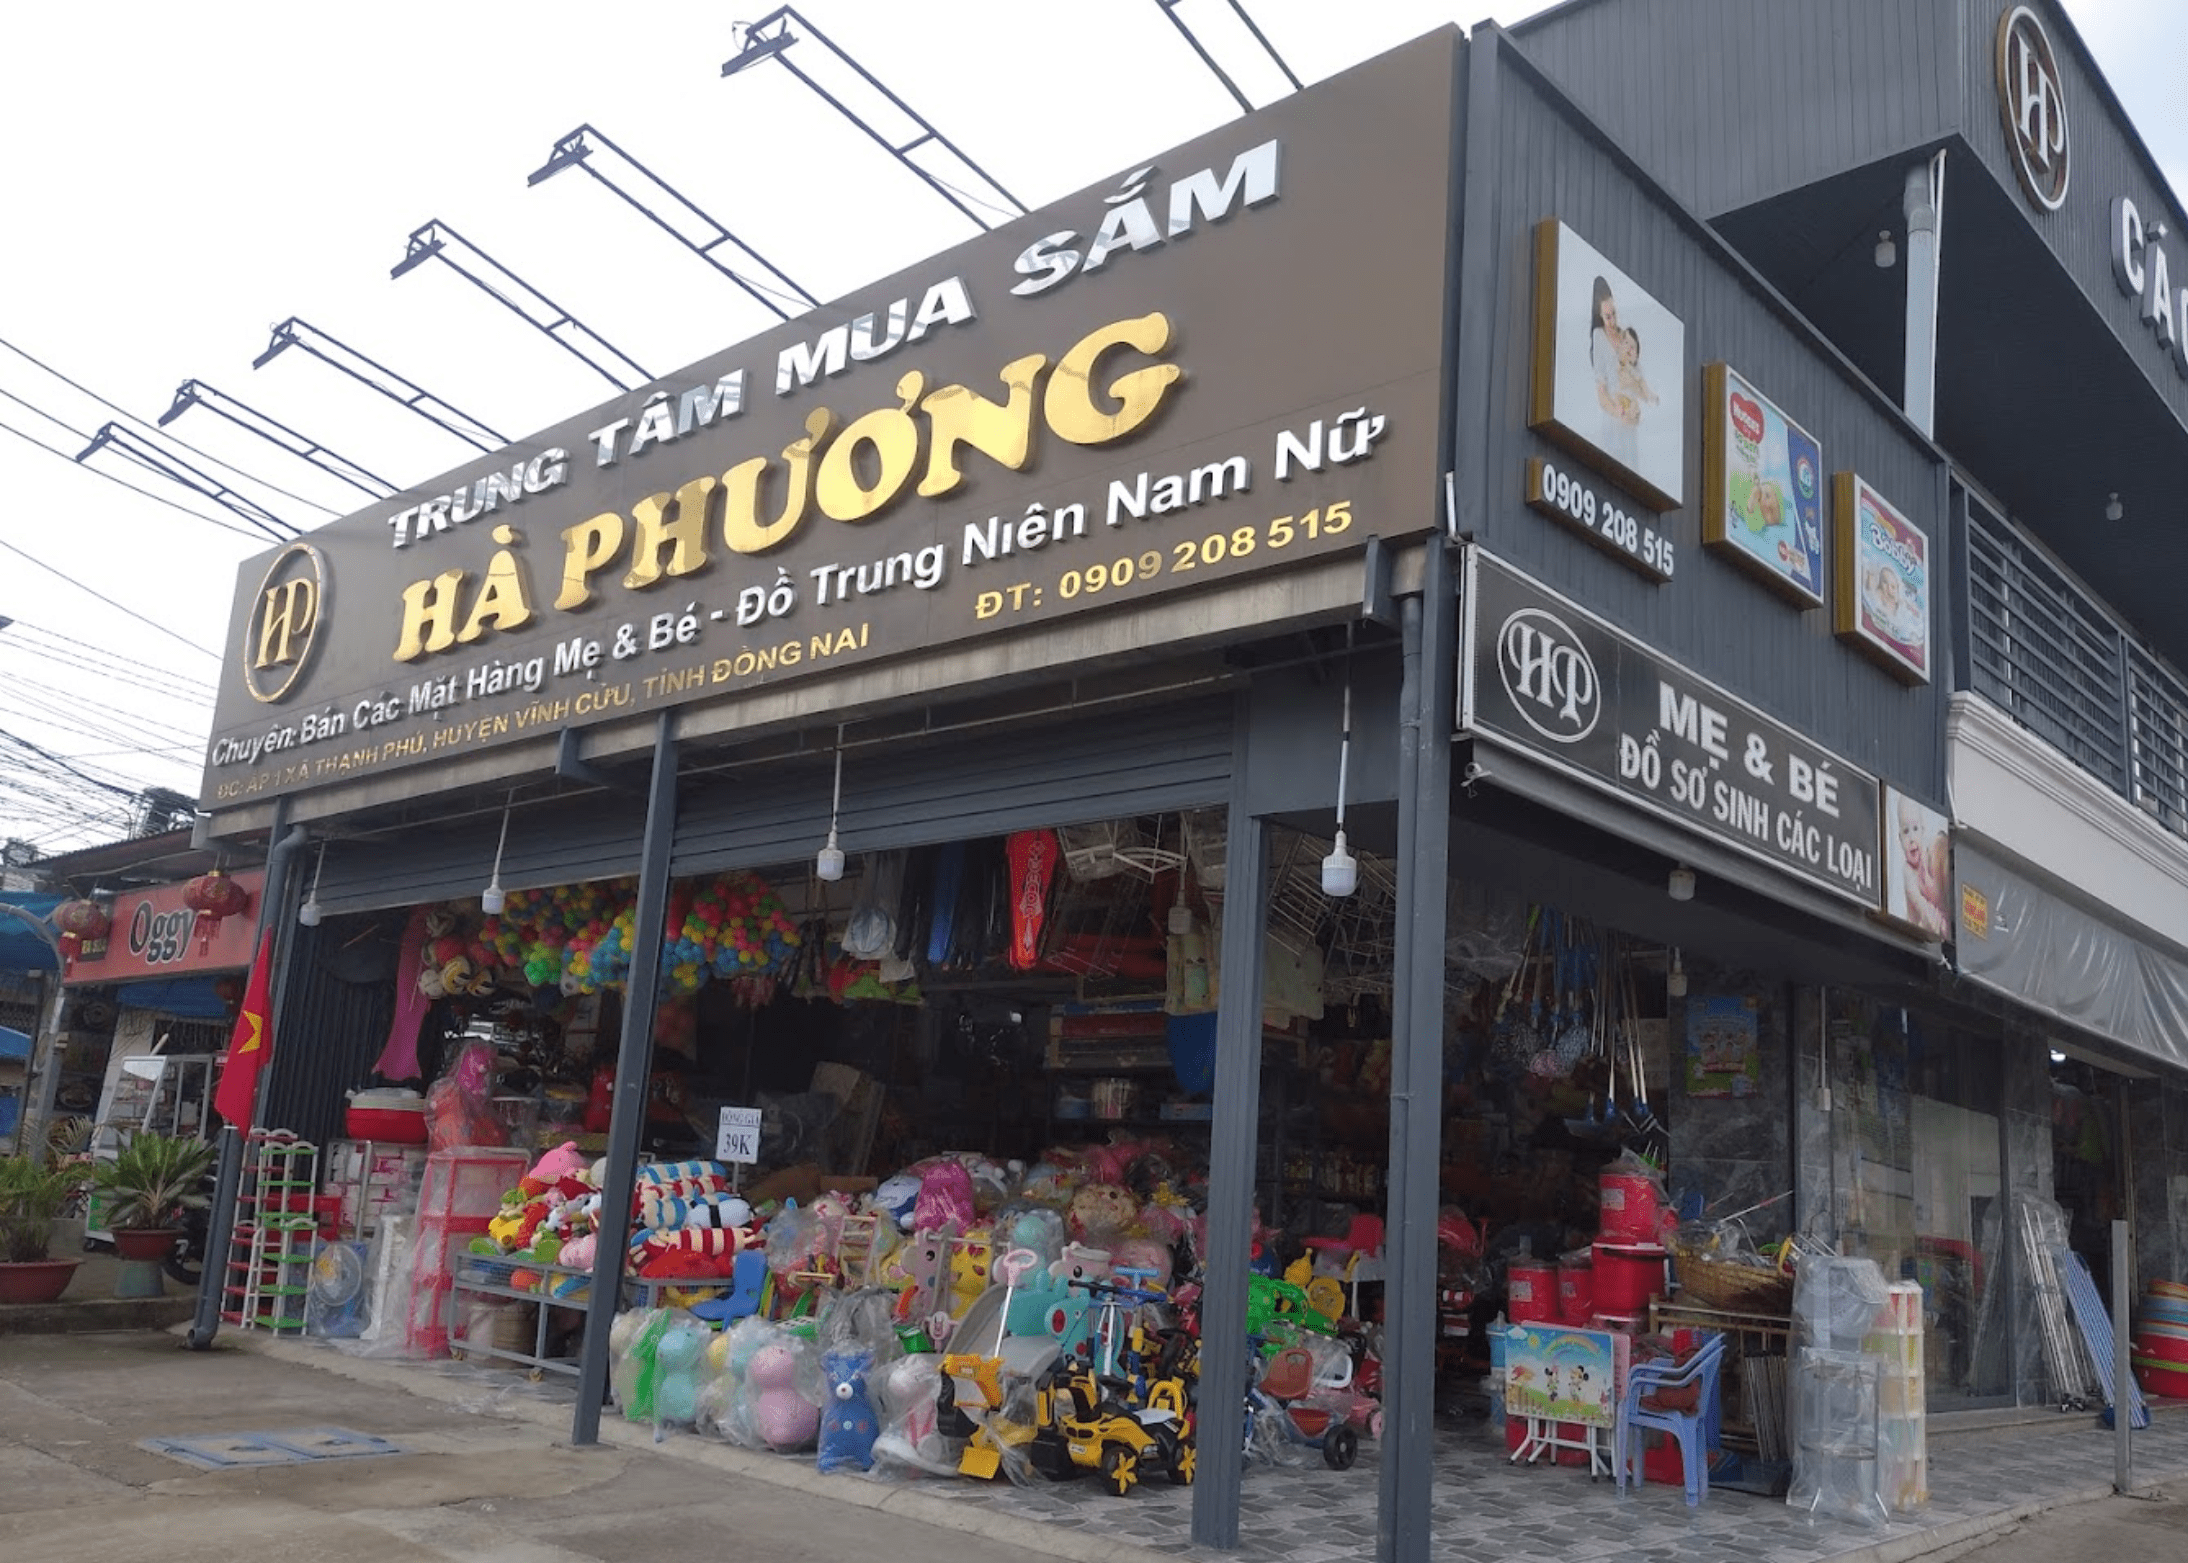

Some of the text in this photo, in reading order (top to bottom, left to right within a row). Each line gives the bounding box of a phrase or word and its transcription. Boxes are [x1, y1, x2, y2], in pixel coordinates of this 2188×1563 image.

[388, 139, 1281, 548] TRUNG TÂM MUA SẮM
[555, 312, 1186, 610] PHƯƠNG
[1543, 464, 1674, 576] 0909 208 515
[212, 723, 297, 767] Chuyên:
[301, 706, 345, 744] Bán
[353, 690, 400, 730] Các
[408, 674, 459, 720] Mặt
[466, 655, 544, 699] Hàng
[553, 637, 602, 680] Mẹ
[612, 623, 638, 659] &
[649, 602, 698, 650] Bé
[737, 566, 795, 626] Đồ
[810, 544, 944, 605] Trung
[1106, 456, 1250, 527] Nam
[1275, 406, 1386, 481] Nữ
[975, 501, 1352, 619] ĐT: 0909 208 515
[284, 759, 310, 784] XÃ
[315, 745, 379, 776] THẠNH
[382, 730, 428, 761] PHÚ,
[433, 713, 509, 748] HUYỆN
[515, 696, 570, 730] VĨNH
[575, 681, 635, 716] CỬU,
[711, 640, 802, 684] ĐỒNG
[810, 622, 869, 660] NAI
[1658, 680, 1840, 818] MẸ & BÉ
[1619, 728, 1873, 891] ĐỒ SƠ SINH CÁC LOẠI
[130, 900, 193, 965] Oggy
[724, 1133, 751, 1155] 39K
